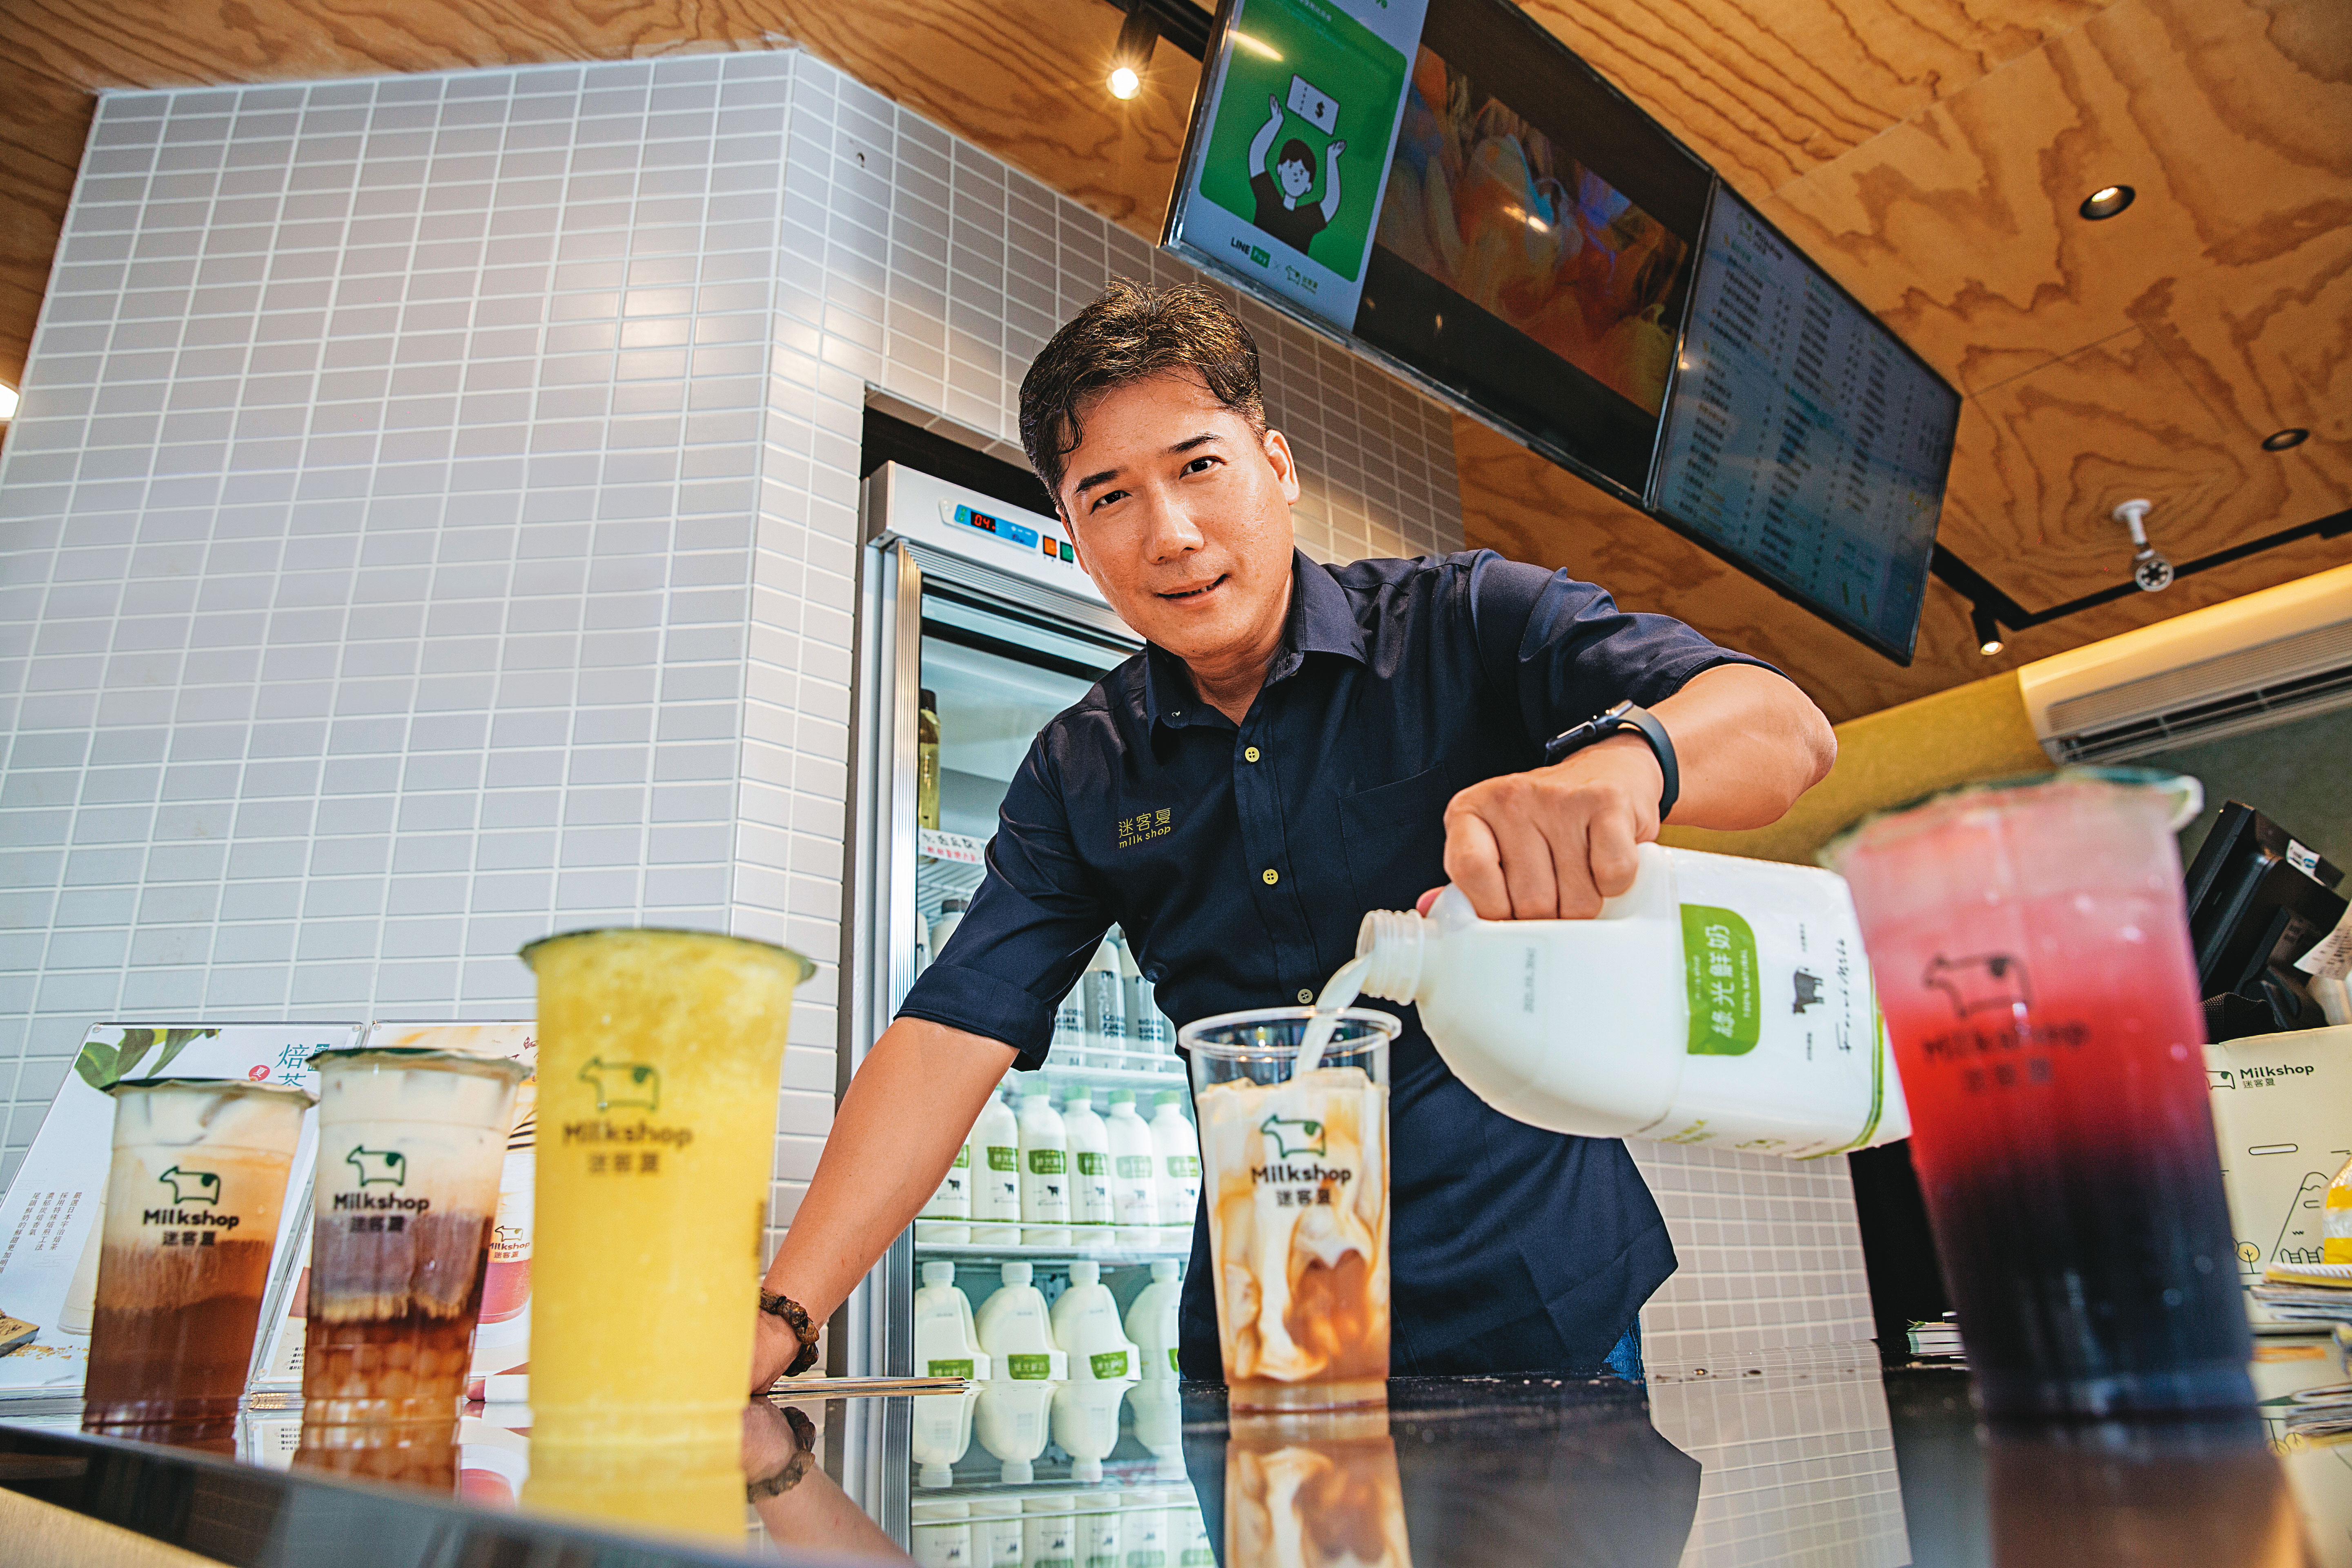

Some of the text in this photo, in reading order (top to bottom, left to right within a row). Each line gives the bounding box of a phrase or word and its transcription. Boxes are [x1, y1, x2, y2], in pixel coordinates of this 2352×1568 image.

[1231, 236, 1251, 255] LINE
[1118, 808, 1171, 838] 迷客夏
[1705, 924, 1735, 1038] 綠光鮮奶
[2240, 1065, 2314, 1079] Milkshop
[2243, 1078, 2276, 1088] 迷客夏
[1251, 1163, 1352, 1186] Milkshop
[28, 1192, 55, 1236] 濃郁炭焙香氣
[333, 1192, 430, 1215] Milkshop
[34, 1192, 69, 1251] 採用特殊焙煎工法
[49, 1192, 82, 1251] 嚴選日本宇治焙茶
[144, 1209, 240, 1231] Milkshop
